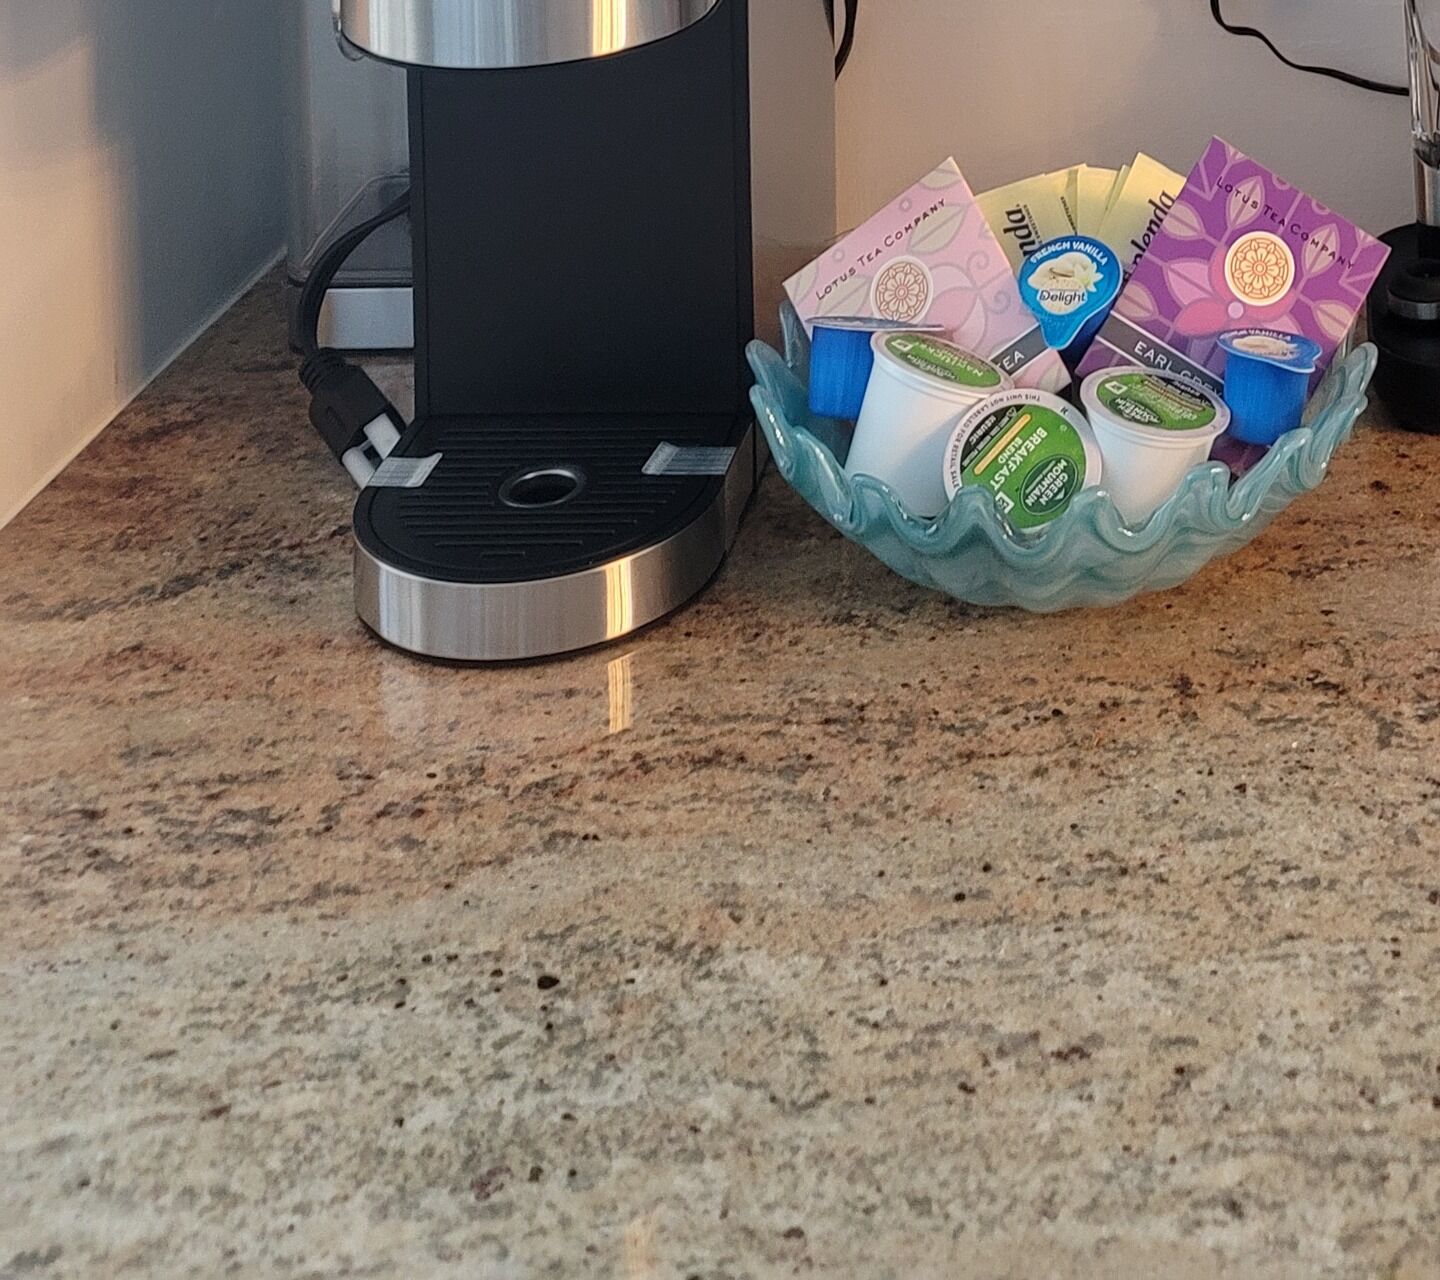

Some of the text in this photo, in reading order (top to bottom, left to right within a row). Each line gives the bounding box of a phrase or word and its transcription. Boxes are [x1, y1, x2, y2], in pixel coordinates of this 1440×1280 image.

[1216, 176, 1355, 269] LOTUS TEA COMPANY
[815, 198, 946, 301] LOTUS TEA COMPANY
[1030, 241, 1108, 265] FRENCH VANILLA
[1039, 289, 1086, 305] Delight
[997, 350, 1025, 370] EA
[1134, 341, 1174, 371] EARL
[990, 427, 1048, 490] BREAKFAST
[998, 436, 1023, 464] BLEND
[1025, 459, 1068, 506] MOUNTAIN
[1039, 472, 1068, 505] GREEN
